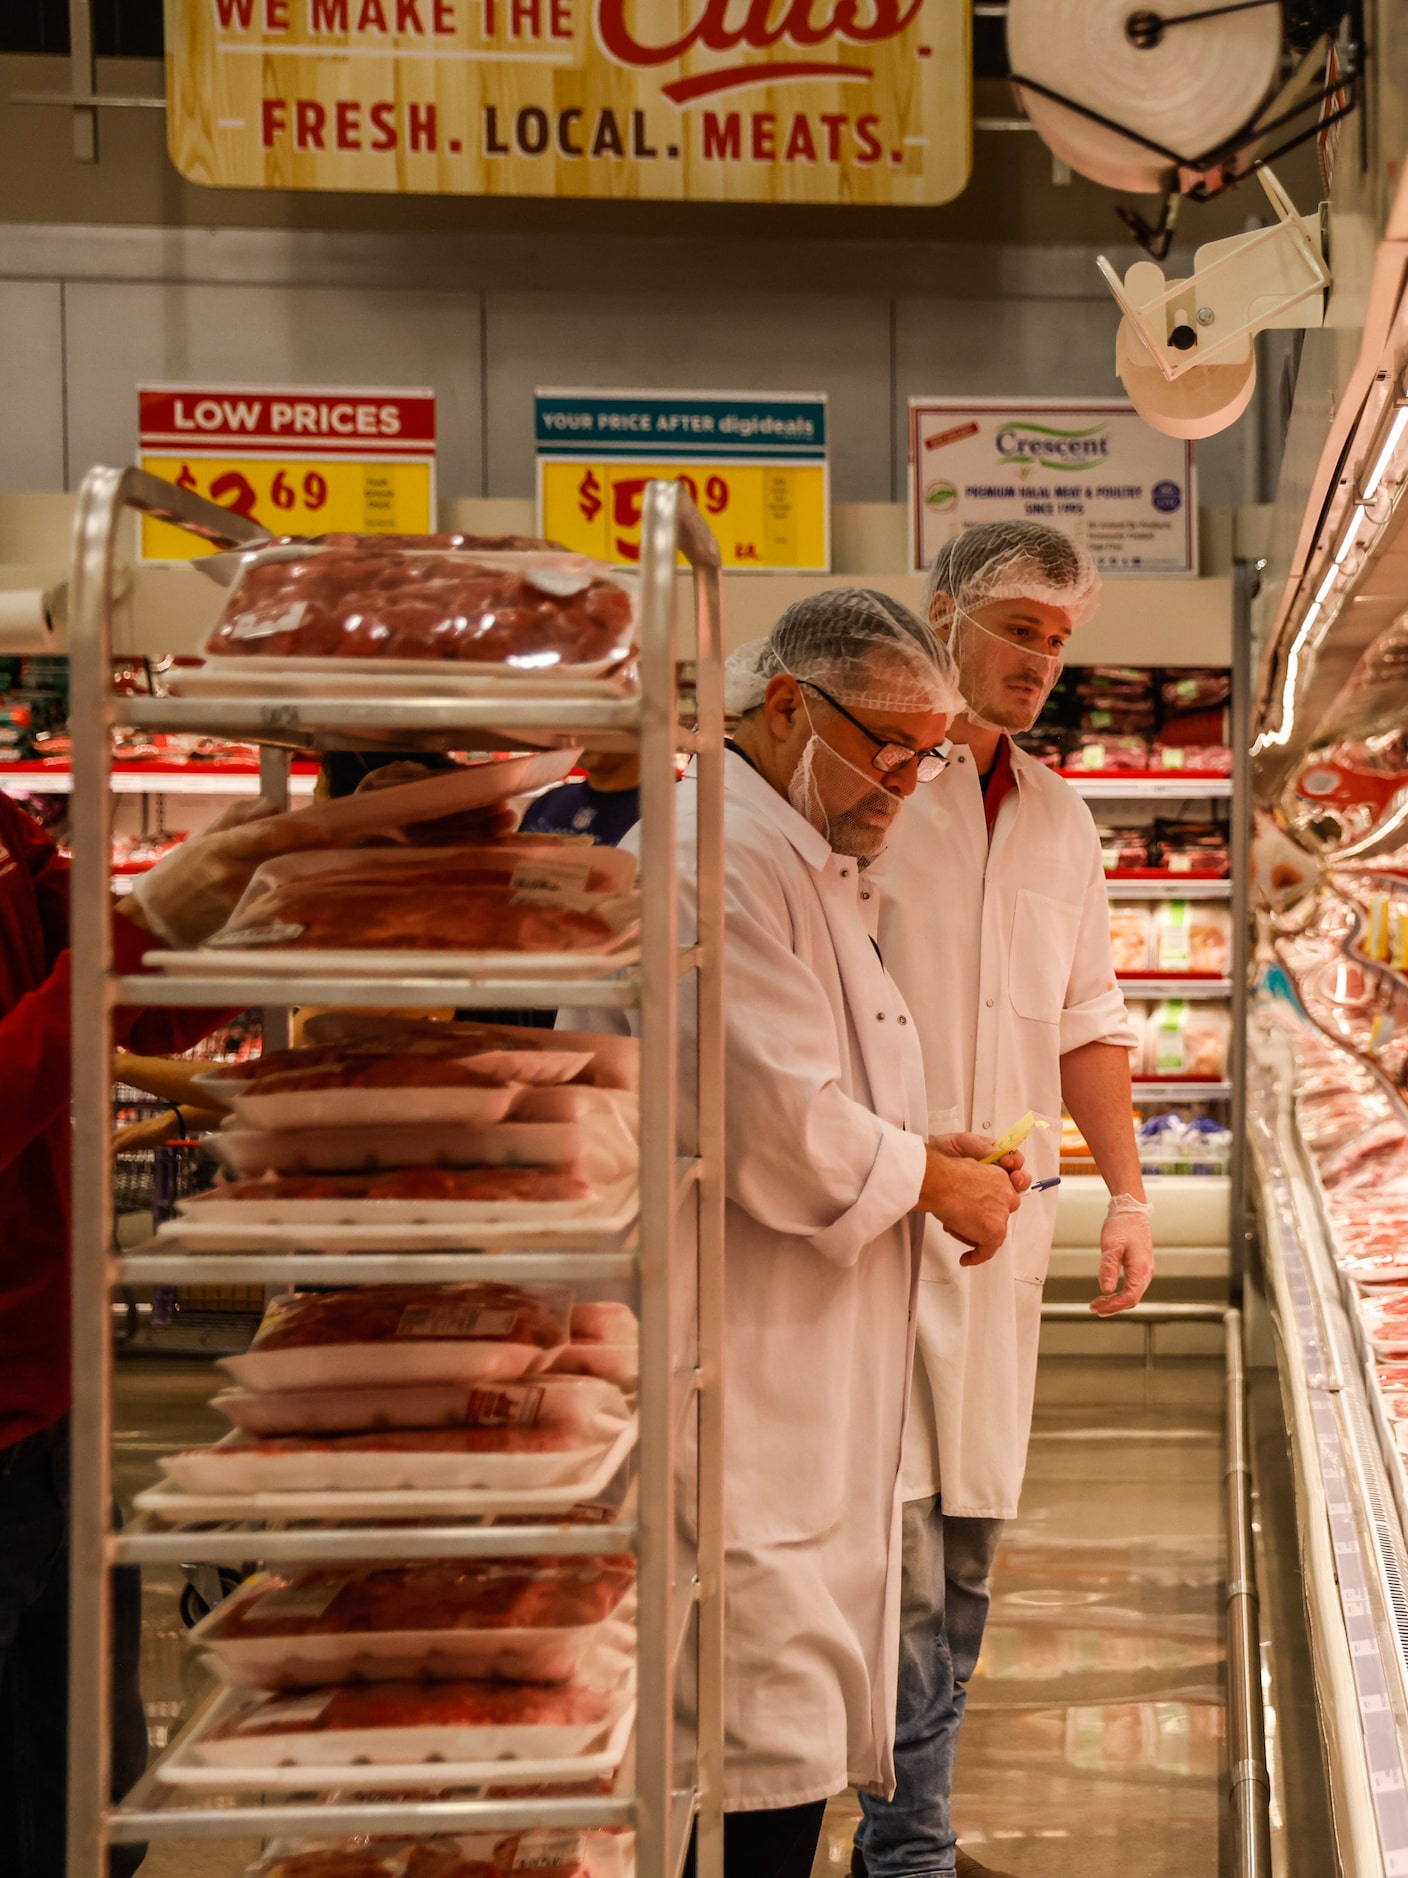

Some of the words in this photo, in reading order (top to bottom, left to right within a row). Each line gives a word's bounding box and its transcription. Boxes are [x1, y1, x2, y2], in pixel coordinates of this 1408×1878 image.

[215, 0, 291, 31] WE
[311, 0, 456, 36] MAKE
[482, 0, 574, 39] THE
[261, 99, 462, 154] FRESH.
[484, 105, 679, 159] LOCAL.
[702, 111, 904, 164] MEATS.
[174, 400, 261, 431] LOW
[271, 405, 401, 435] PRICES
[542, 413, 593, 430] YOUR
[598, 414, 651, 431] PRICE
[656, 416, 714, 433] AFTER
[718, 416, 814, 436] digideals
[996, 431, 1109, 456] Crescent
